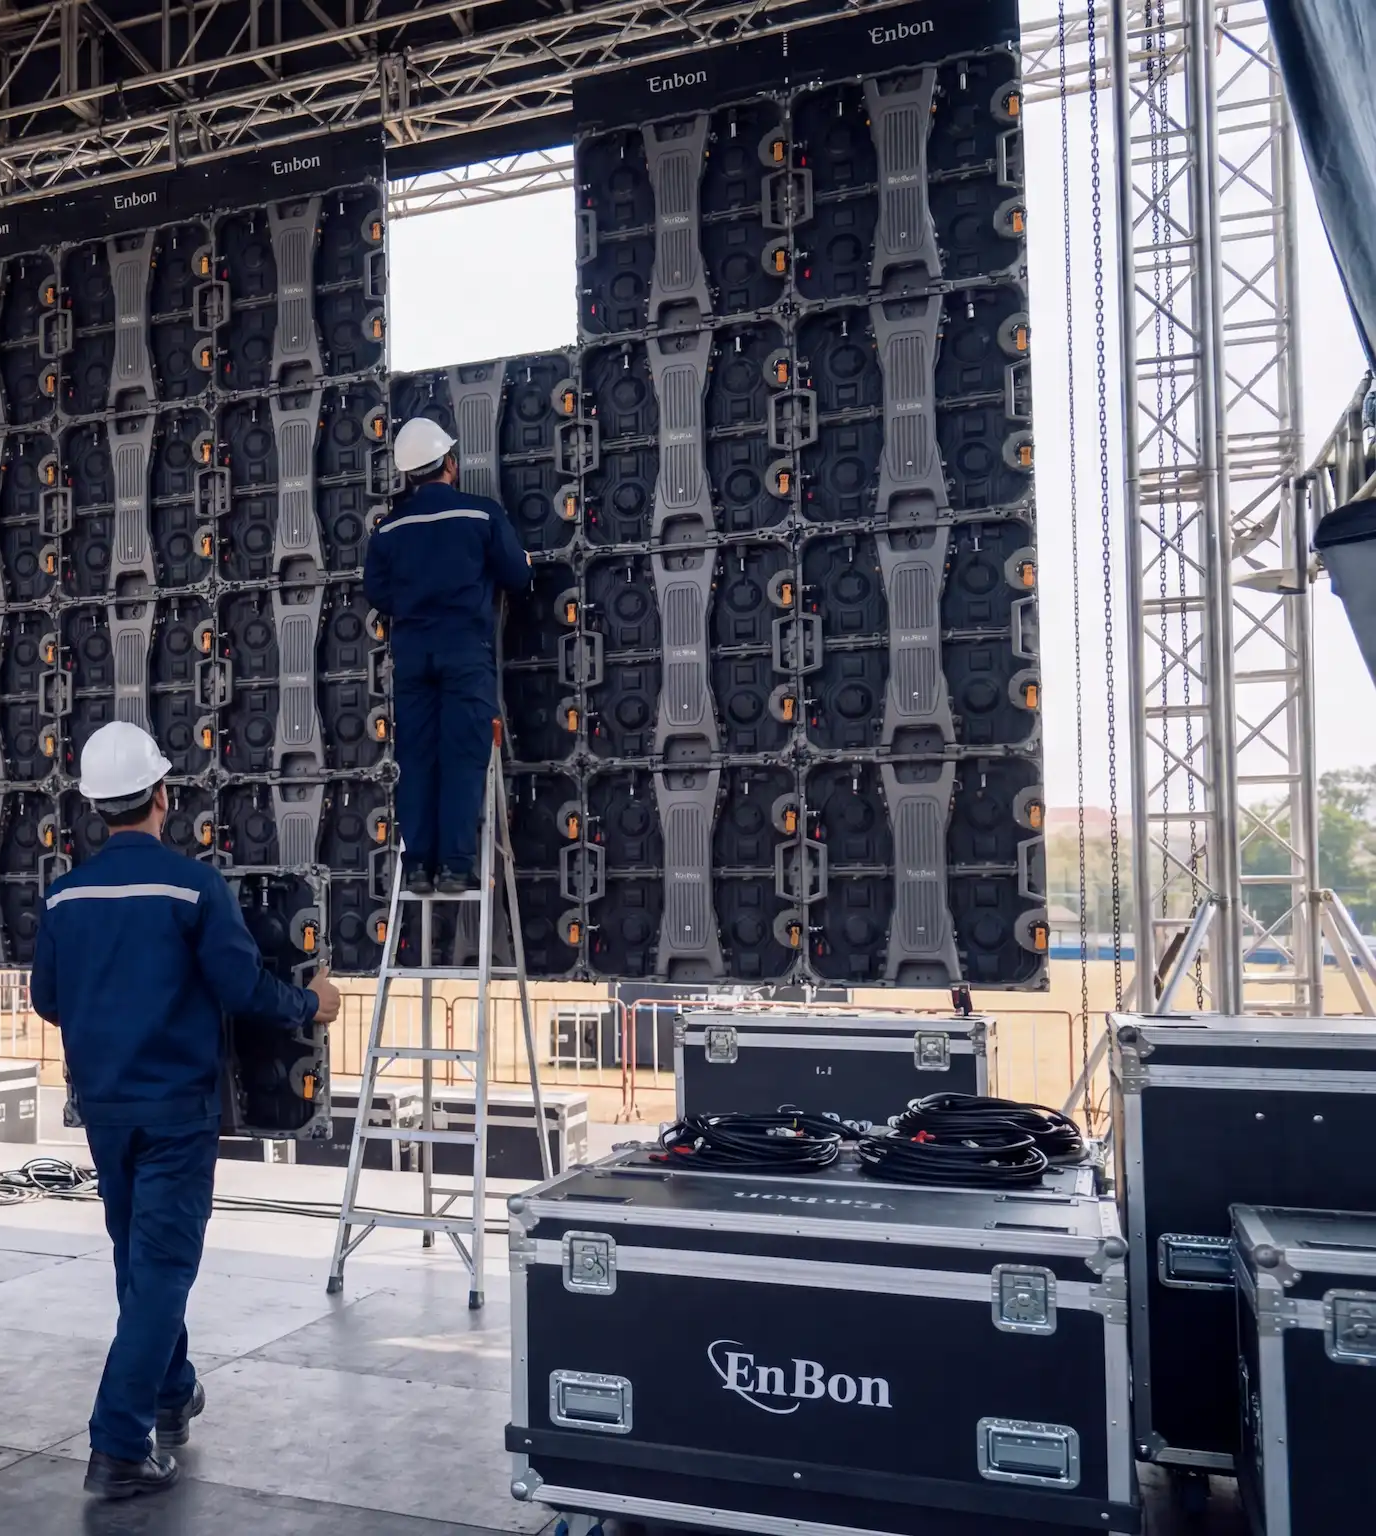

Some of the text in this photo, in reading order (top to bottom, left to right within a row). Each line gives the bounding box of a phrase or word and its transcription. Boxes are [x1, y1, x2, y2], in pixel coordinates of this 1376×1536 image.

[867, 19, 934, 45] Enbon
[646, 70, 707, 93] Enbon
[271, 156, 321, 175] Enbon
[113, 191, 157, 210] Enbon
[722, 1351, 893, 1408] EnBon
